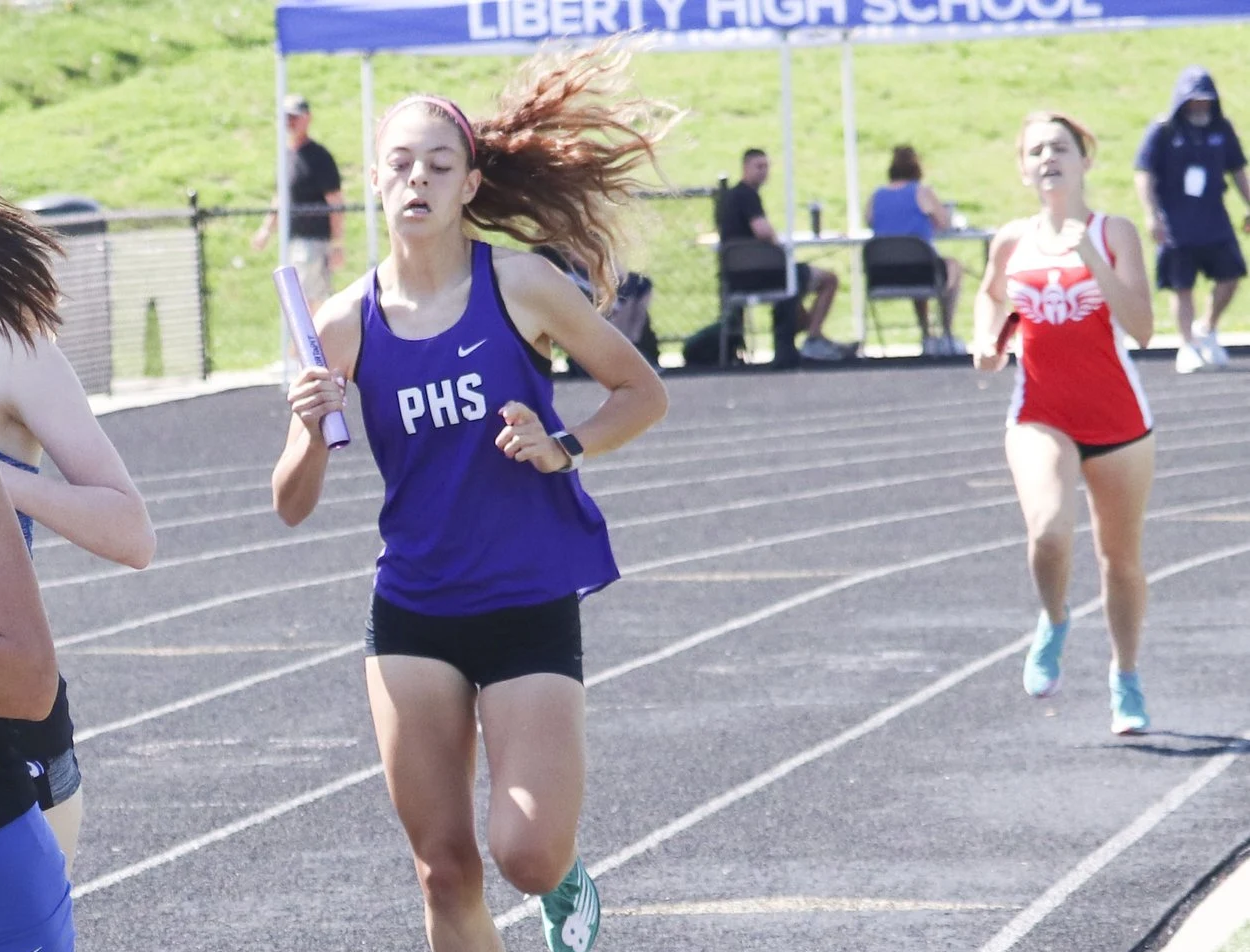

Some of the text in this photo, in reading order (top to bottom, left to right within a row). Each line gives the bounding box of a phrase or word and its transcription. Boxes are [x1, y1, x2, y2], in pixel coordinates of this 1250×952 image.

[467, 0, 685, 40] LIBERTY
[706, 0, 848, 29] HIGH
[861, 0, 1103, 24] SCHOOL
[397, 372, 487, 435] PHS
